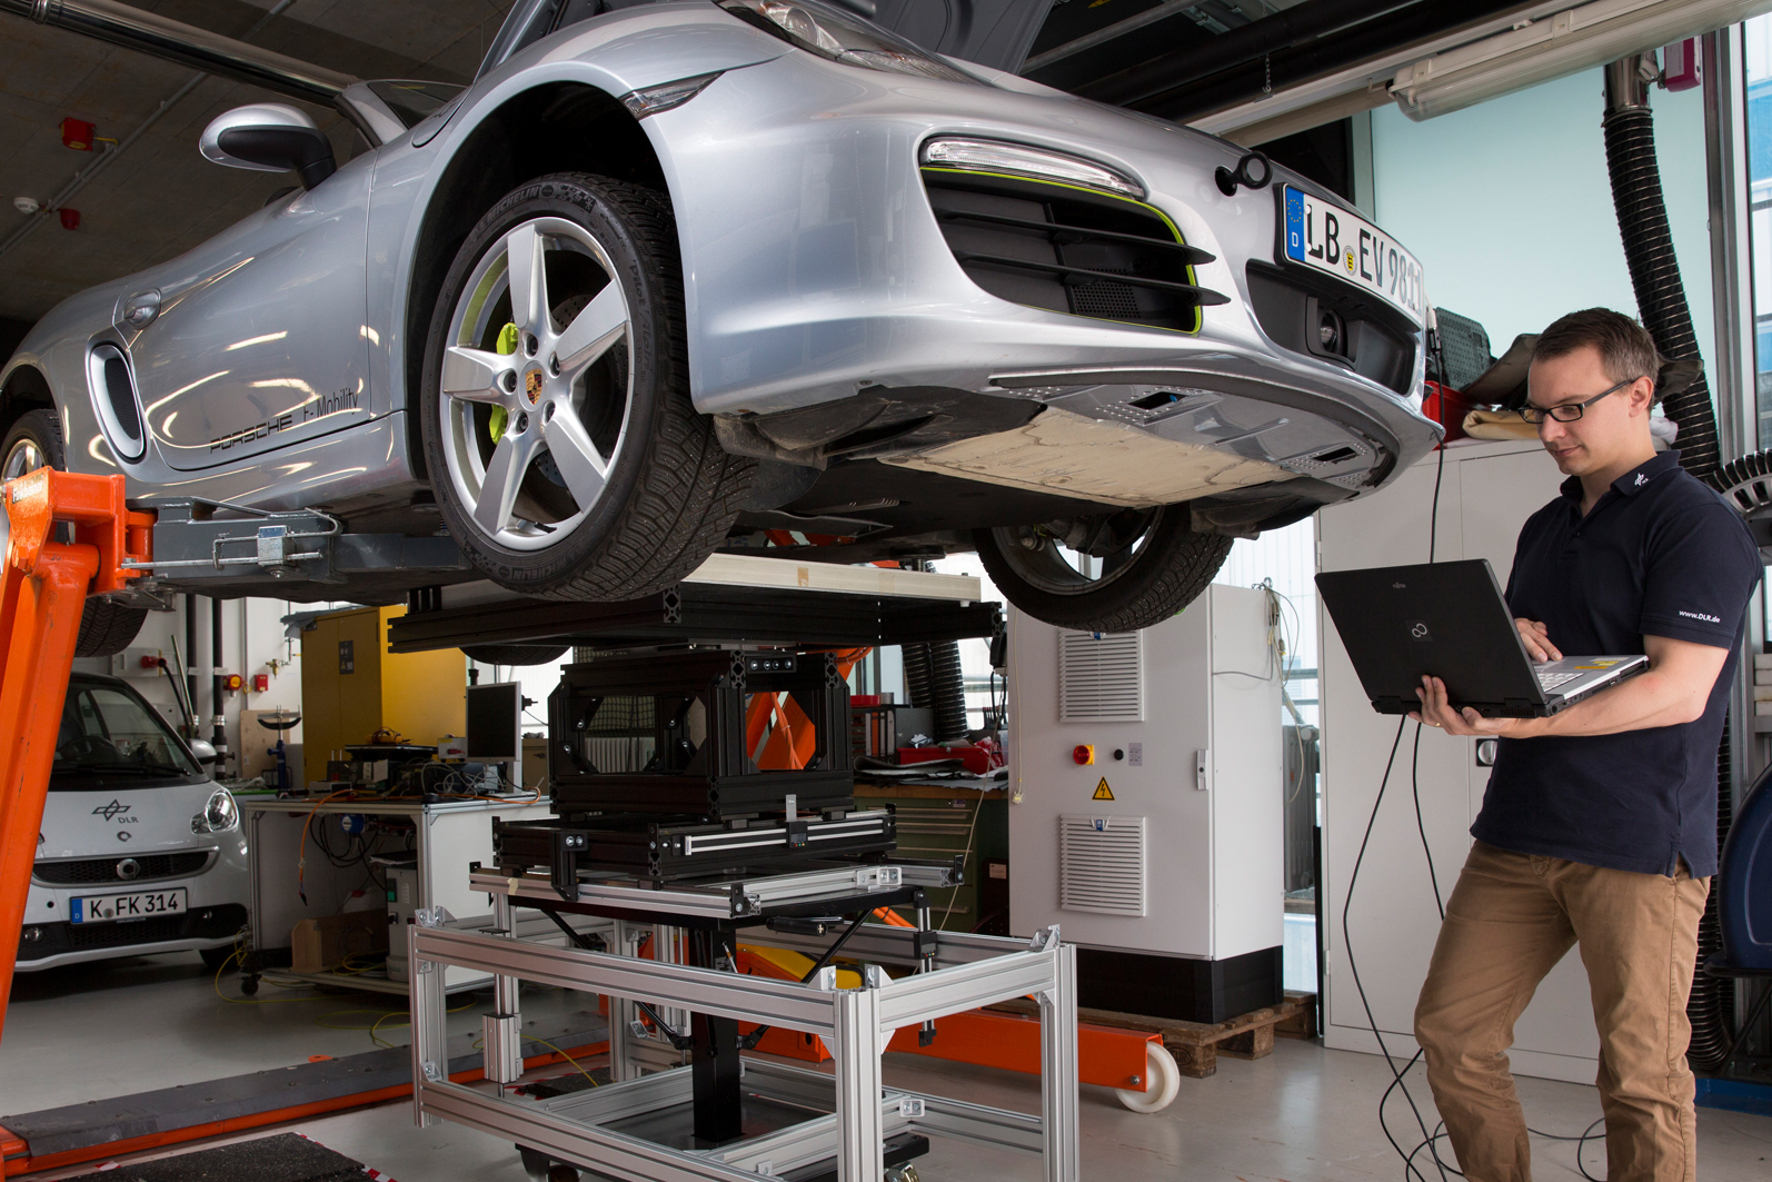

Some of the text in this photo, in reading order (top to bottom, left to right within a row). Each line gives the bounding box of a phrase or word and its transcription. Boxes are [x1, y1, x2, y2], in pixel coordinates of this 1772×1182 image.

[486, 185, 540, 221] MICHELIN
[1291, 232, 1299, 248] D
[1306, 203, 1422, 317] LB EV 9811
[210, 414, 293, 453] PORSCHE
[512, 556, 567, 582] MICHELIN
[1678, 610, 1721, 624] www.DLR.de
[117, 816, 139, 824] DLR
[90, 893, 178, 918] K FK 314
